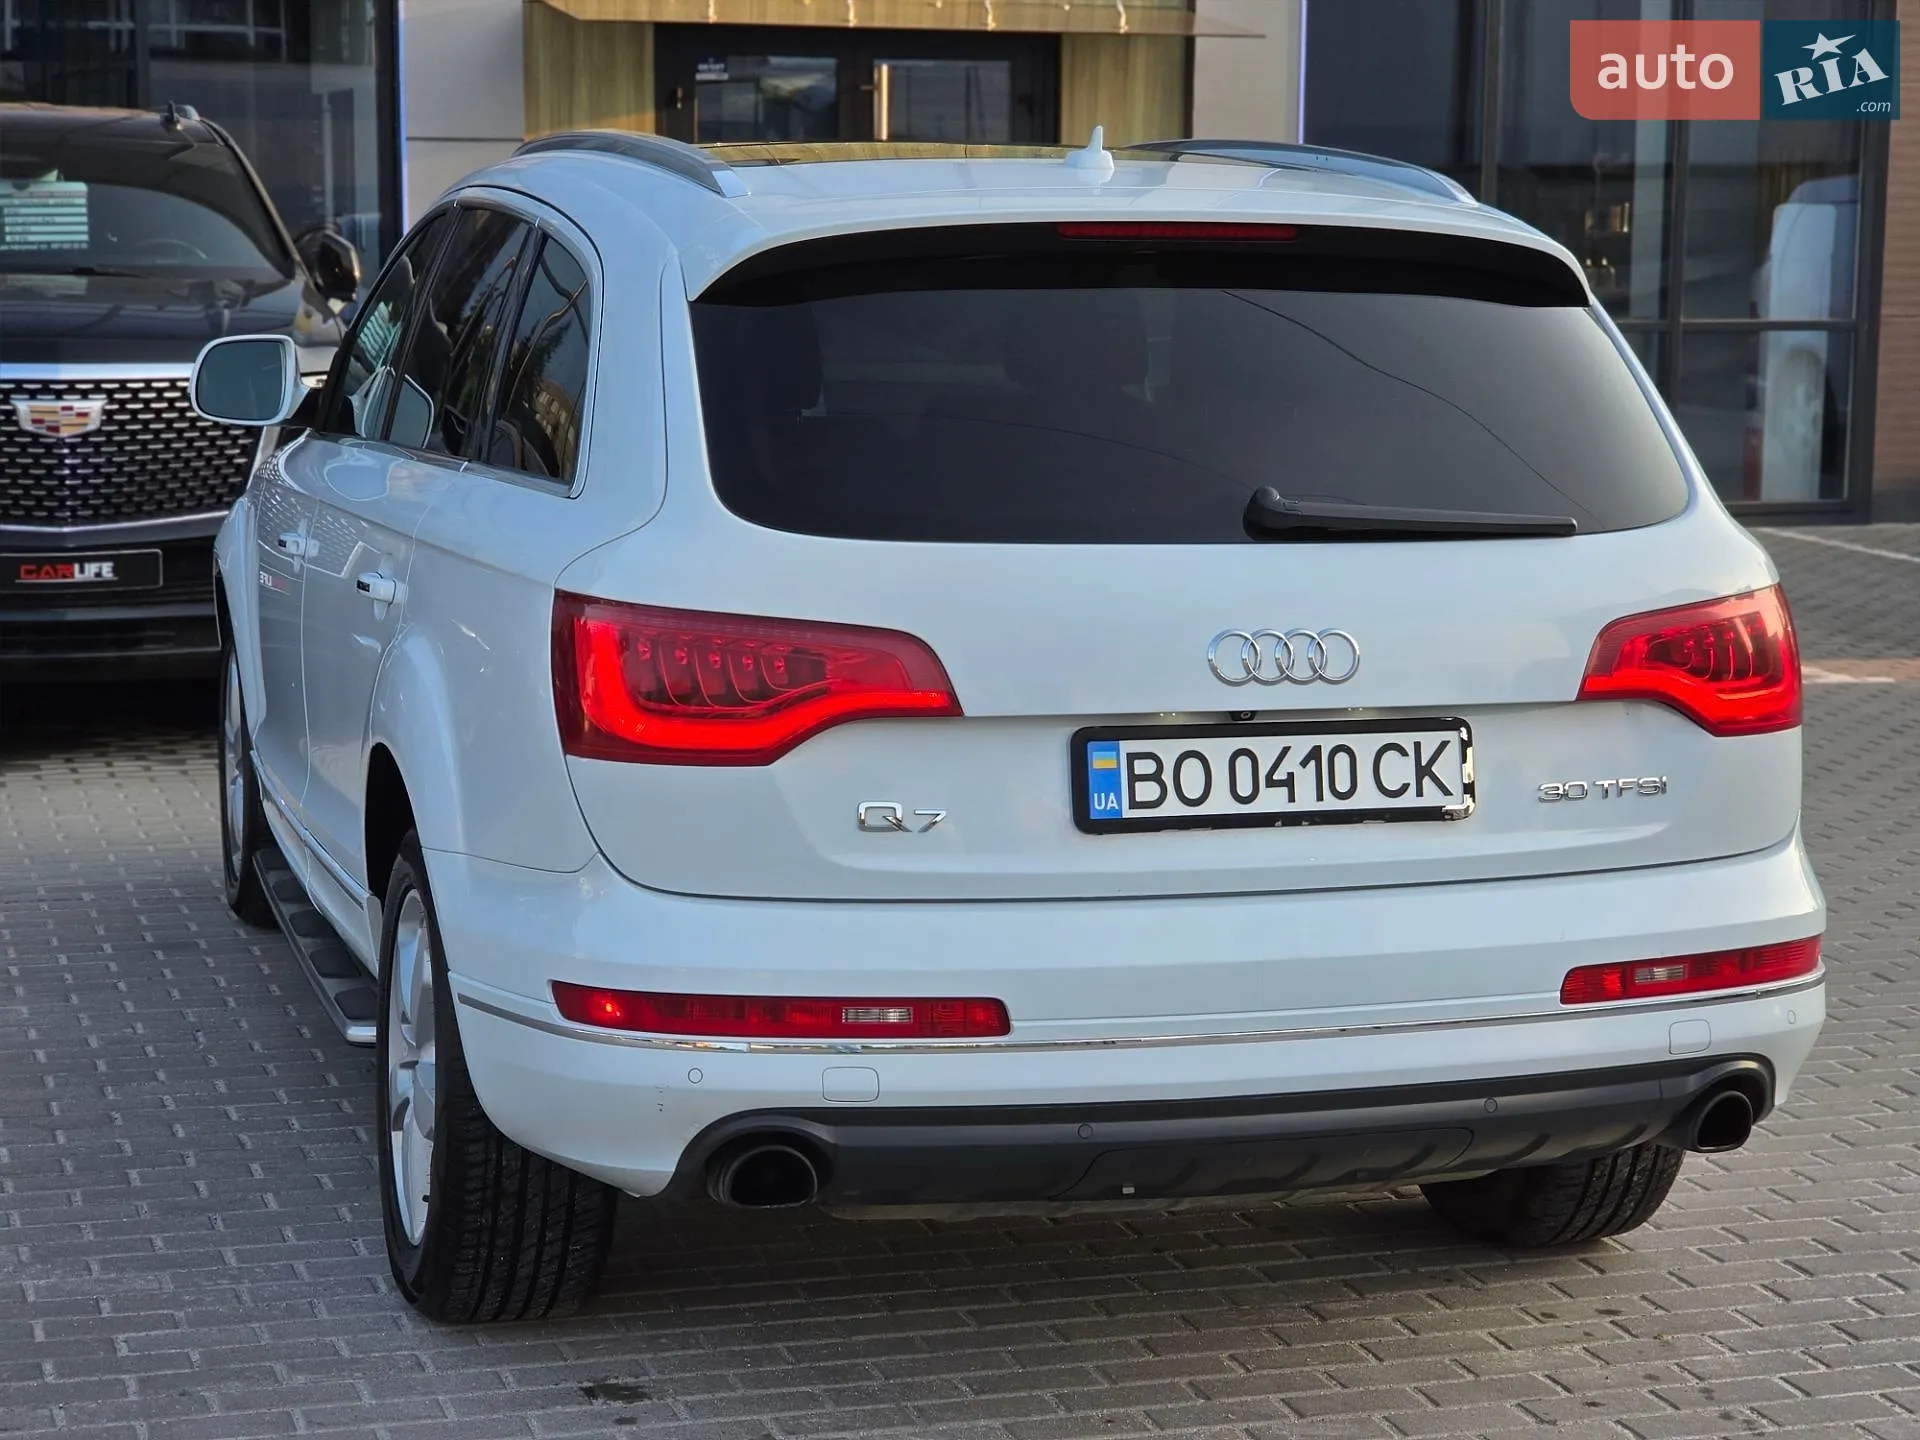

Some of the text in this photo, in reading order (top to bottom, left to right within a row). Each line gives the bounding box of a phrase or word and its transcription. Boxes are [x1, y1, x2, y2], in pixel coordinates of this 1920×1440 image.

[19, 561, 115, 580] CARLIFE
[1126, 740, 1454, 811] BO 0410 CK
[1094, 792, 1119, 810] UA
[1538, 776, 1667, 803] 30 TFSI
[857, 801, 947, 833] Q7
